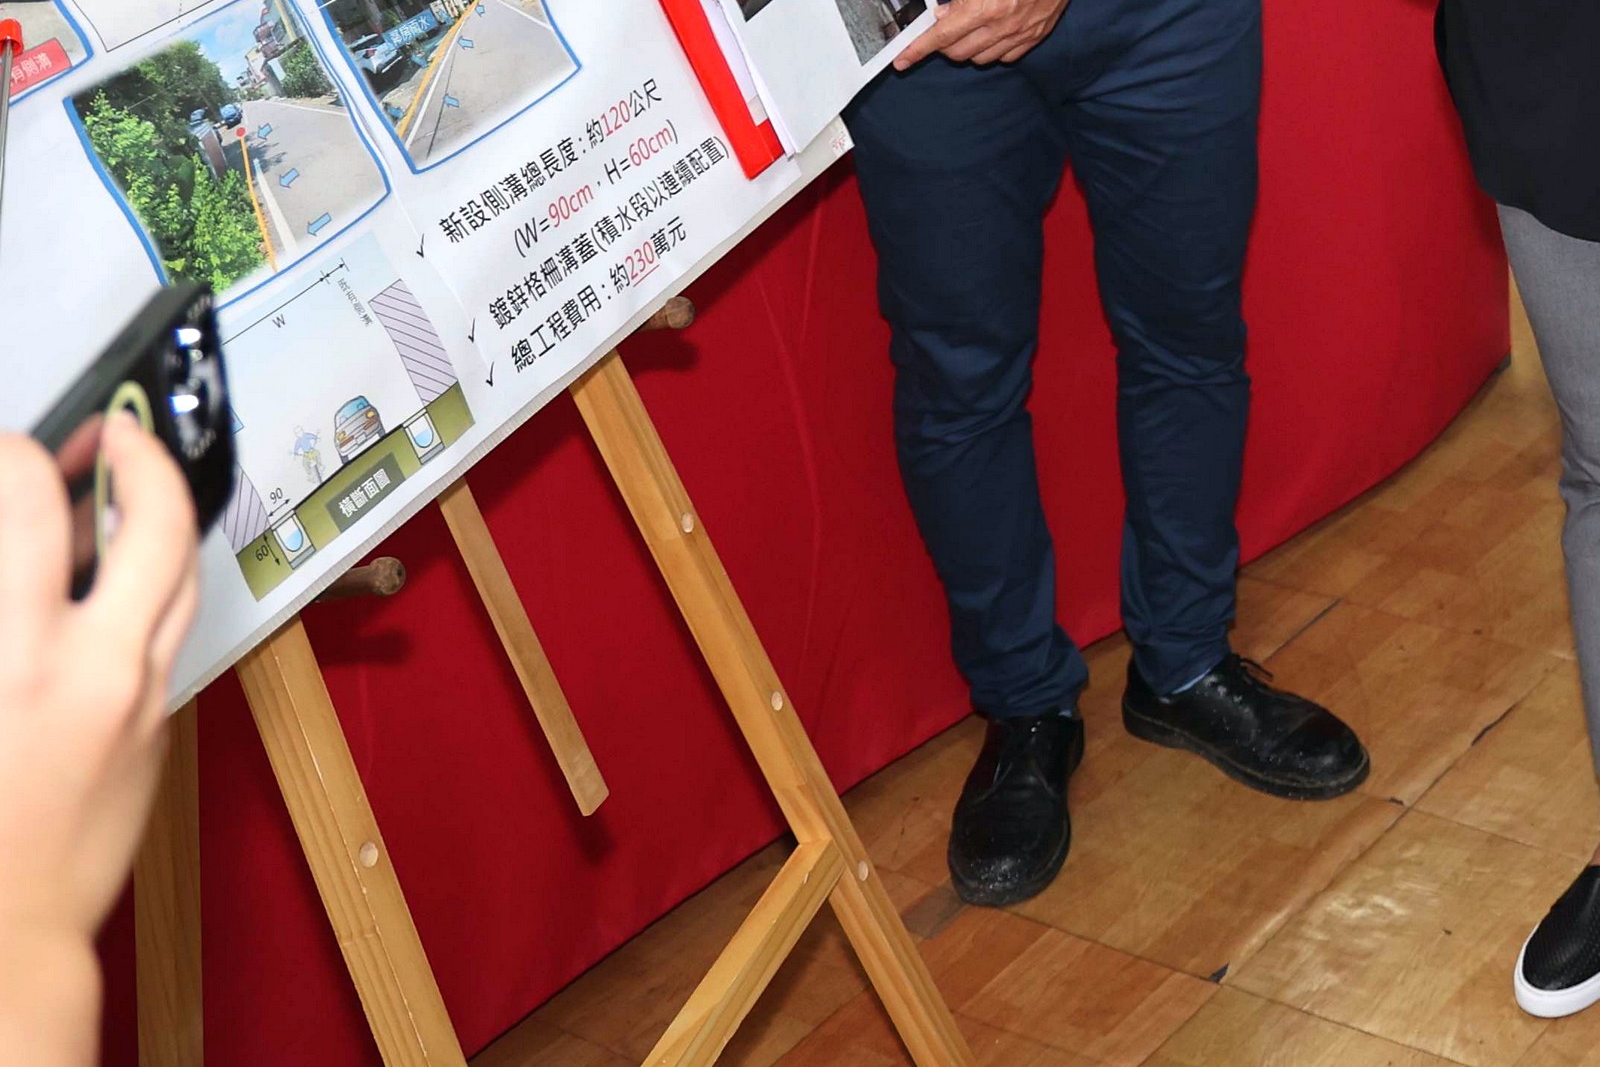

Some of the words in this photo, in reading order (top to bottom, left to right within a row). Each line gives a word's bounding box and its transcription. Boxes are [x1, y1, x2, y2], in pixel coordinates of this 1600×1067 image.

[272, 314, 286, 329] W
[269, 487, 283, 504] 90
[338, 468, 391, 518] 橫斷面圖
[255, 545, 269, 562] 60
